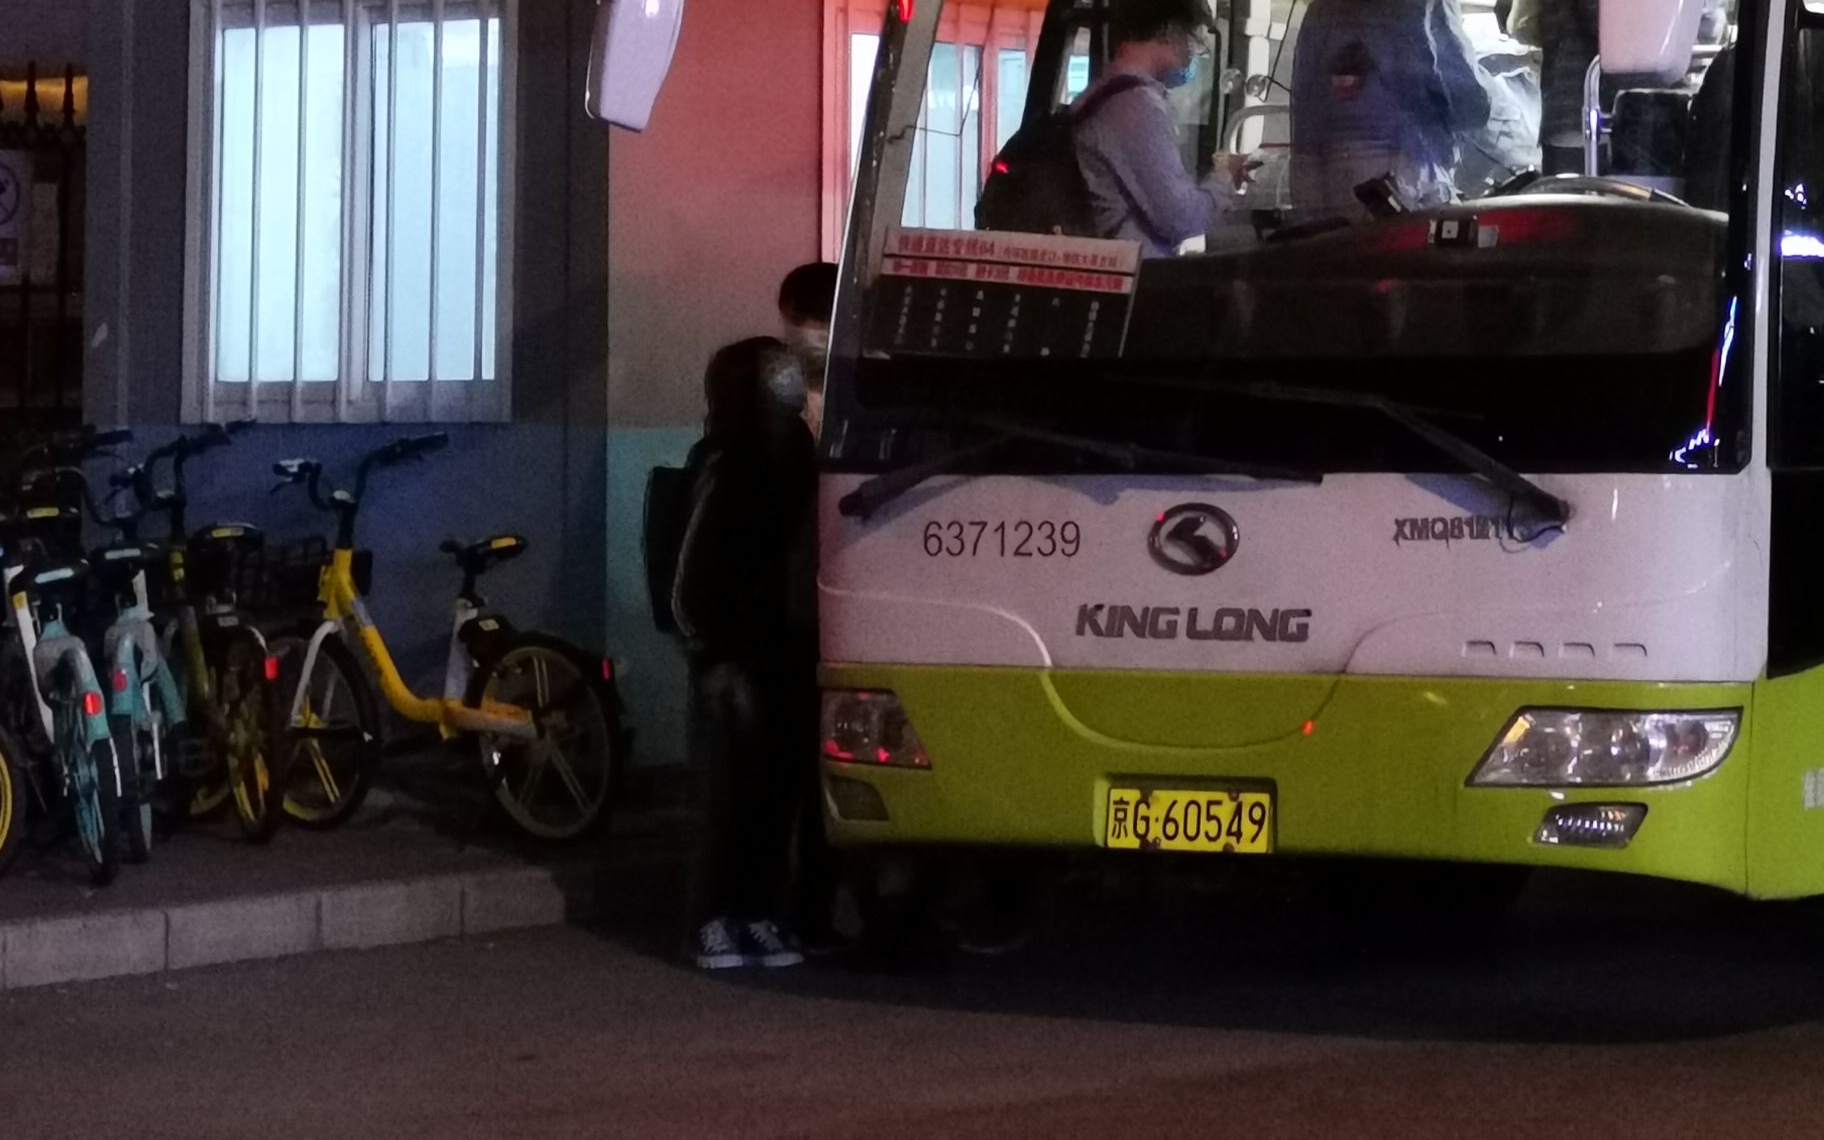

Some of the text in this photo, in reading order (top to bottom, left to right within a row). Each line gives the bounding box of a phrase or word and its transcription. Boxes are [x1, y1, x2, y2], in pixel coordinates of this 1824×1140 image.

[923, 520, 1081, 558] 6371239
[1075, 602, 1313, 643] KING LONG
